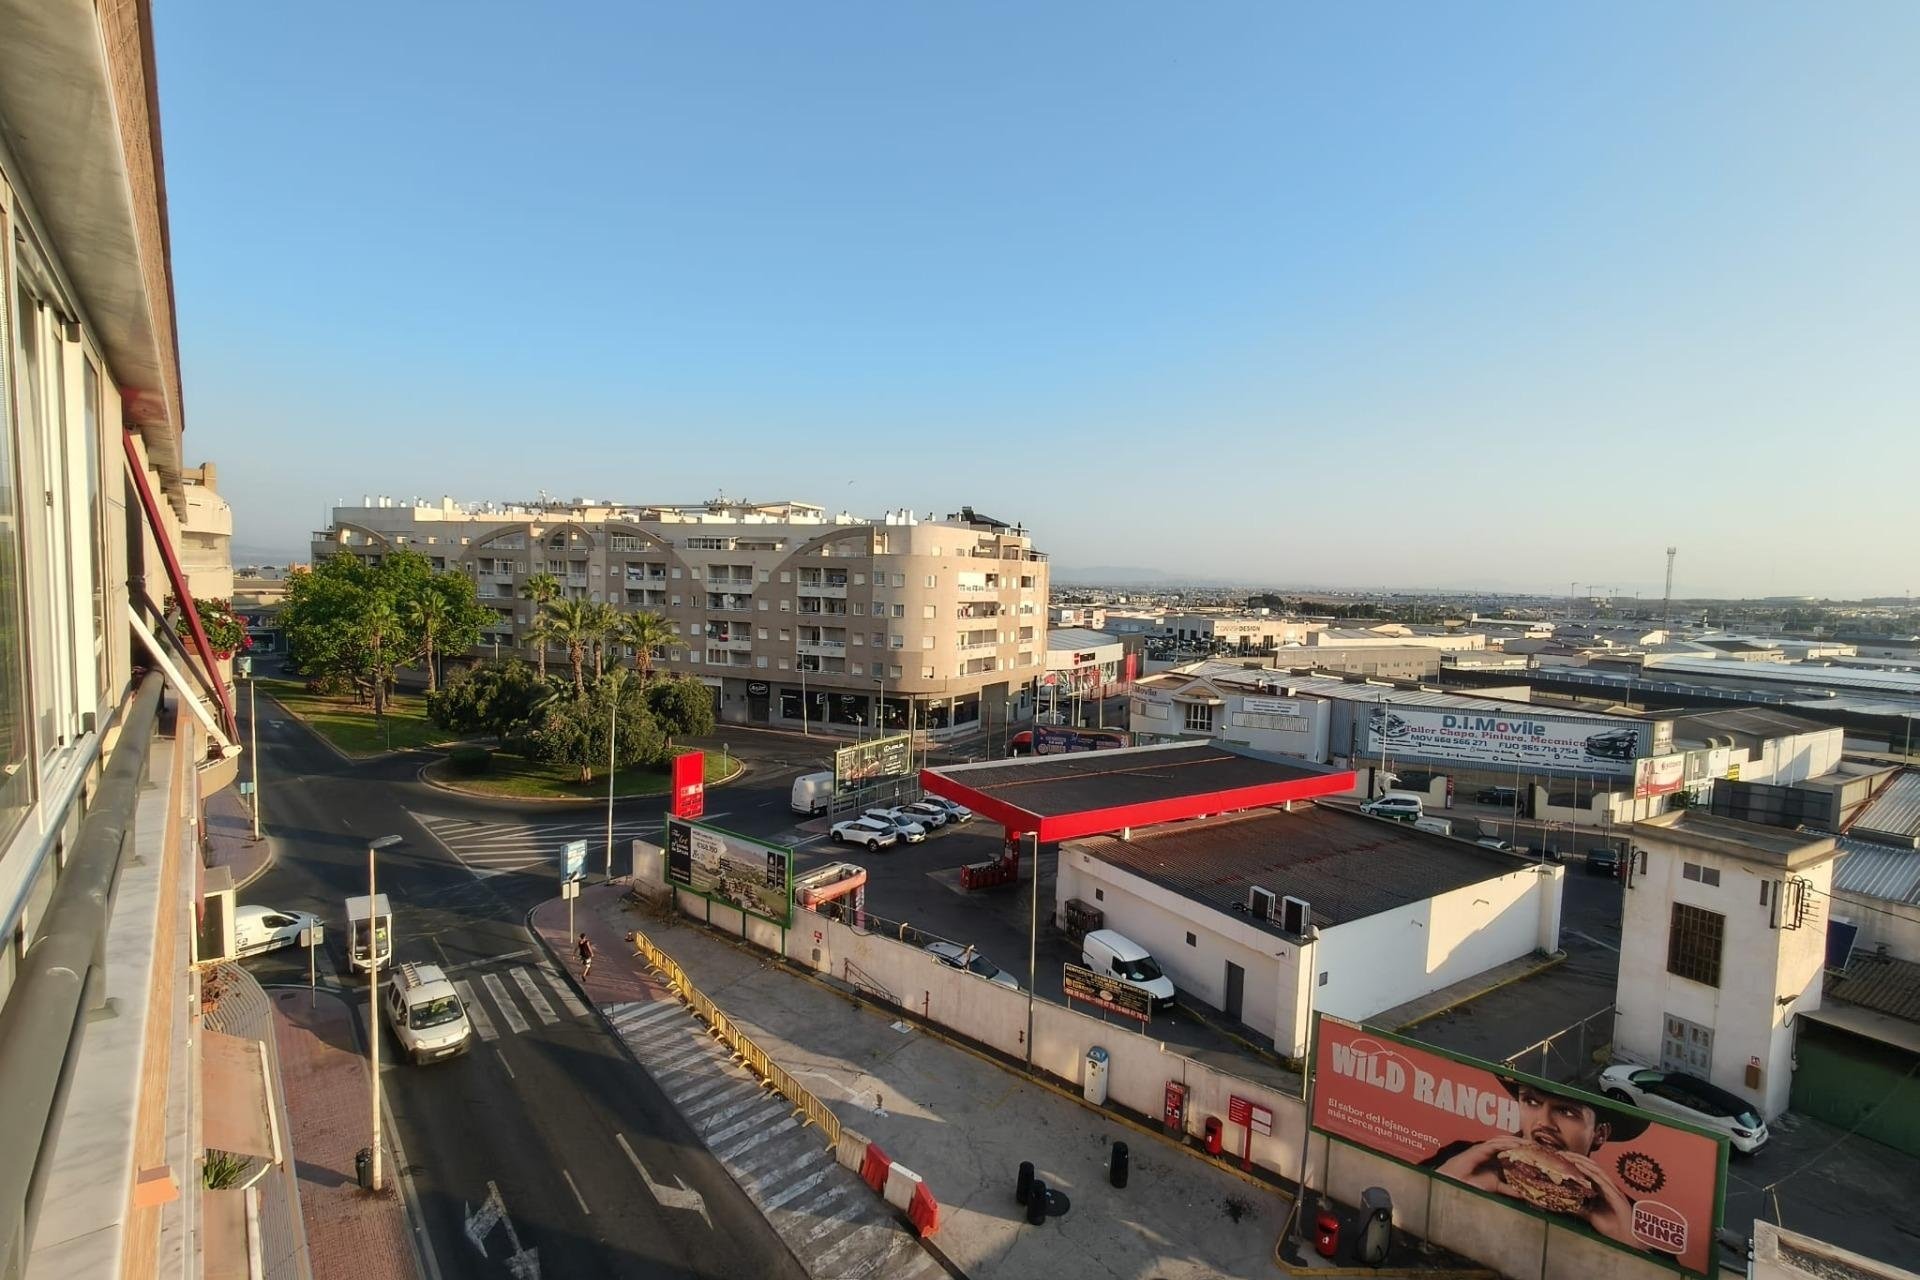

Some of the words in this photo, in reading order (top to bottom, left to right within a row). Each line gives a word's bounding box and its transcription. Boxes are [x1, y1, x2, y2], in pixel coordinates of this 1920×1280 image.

[1404, 725, 1437, 735] Taller
[1442, 714, 1546, 736] D.I.Movile
[1410, 734, 1433, 742] MOV
[1472, 739, 1488, 747] 271
[1331, 1042, 1406, 1094] WILD
[1413, 1069, 1521, 1134] RANCH
[1328, 1098, 1338, 1108] El
[1338, 1103, 1365, 1117] sabor
[1365, 1112, 1381, 1124] del
[1382, 1116, 1410, 1134] lejano
[1411, 1130, 1441, 1148] oeste,
[1328, 1108, 1346, 1120] más
[1347, 1116, 1374, 1131] cerca
[1374, 1125, 1393, 1138] que
[1393, 1132, 1426, 1151] nunca.
[1634, 1209, 1685, 1236] BURGER
[1634, 1219, 1685, 1247] KING
